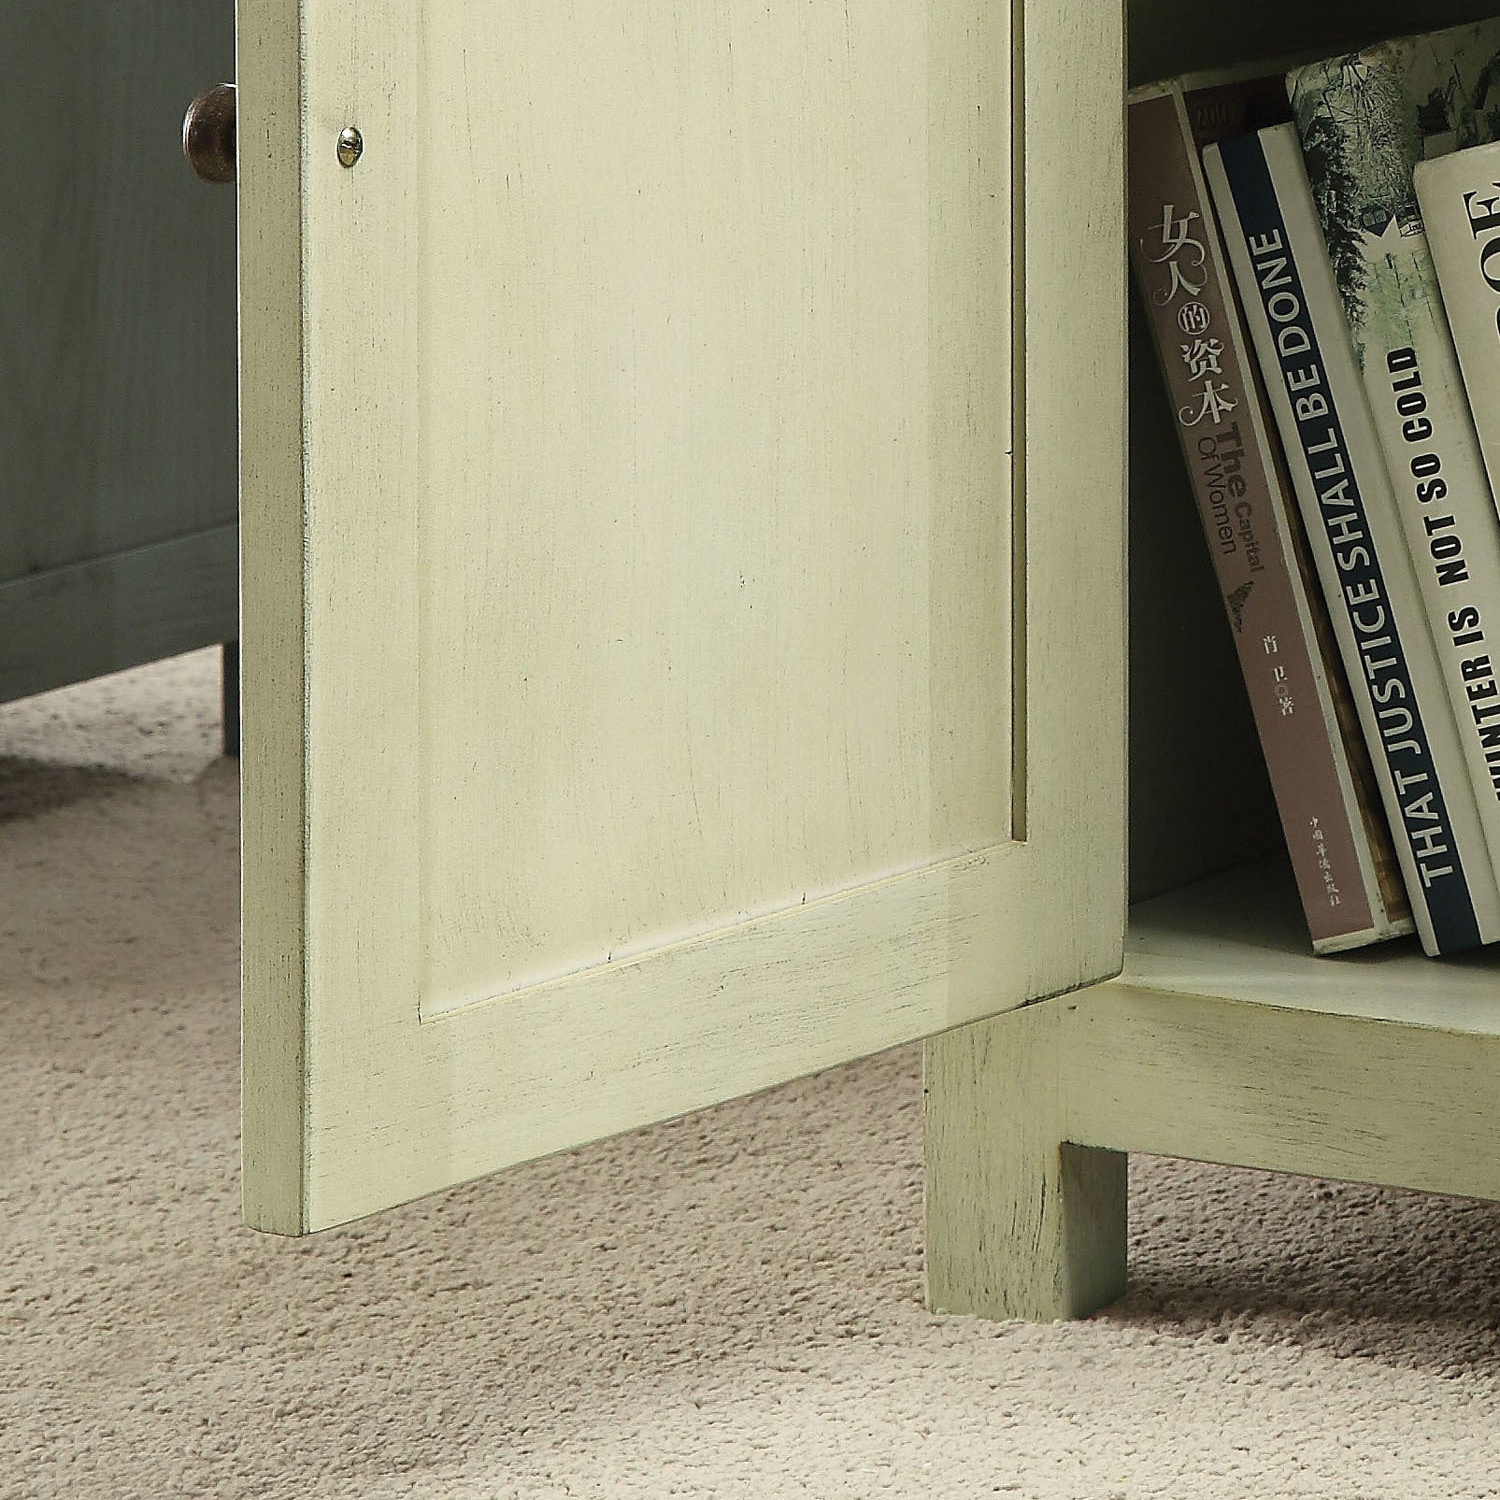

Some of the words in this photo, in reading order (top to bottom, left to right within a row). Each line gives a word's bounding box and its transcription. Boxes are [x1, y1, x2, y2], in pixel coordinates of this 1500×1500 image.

[1140, 203, 1238, 427] 女人的资本
[1249, 228, 1313, 357] DONE
[1287, 363, 1329, 421] BE
[1386, 346, 1434, 444] COLD
[1203, 460, 1237, 555] Women
[1215, 420, 1247, 499] The
[1308, 427, 1371, 572] SHALL
[1410, 451, 1448, 504] SO
[1423, 514, 1470, 587] NOT
[1349, 577, 1422, 755] JUSTICE
[1448, 604, 1486, 648] IS
[1394, 770, 1454, 888] THAT
